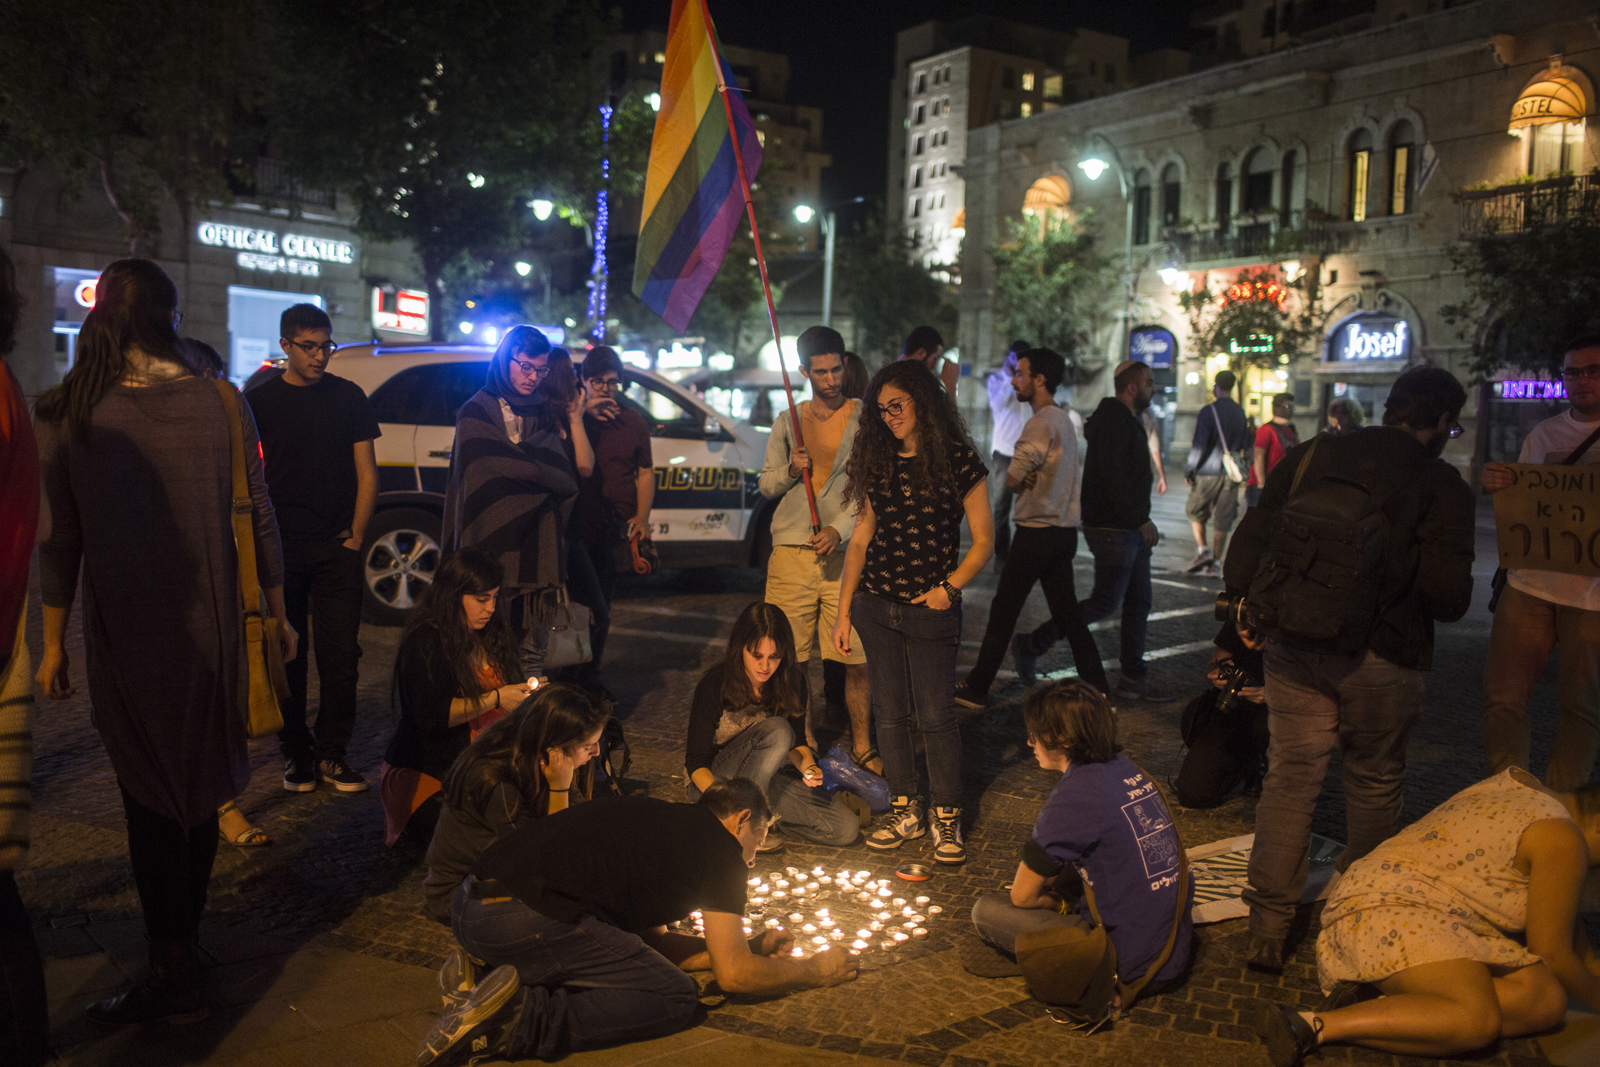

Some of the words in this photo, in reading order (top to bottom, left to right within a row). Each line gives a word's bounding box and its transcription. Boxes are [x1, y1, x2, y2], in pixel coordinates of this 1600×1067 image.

[198, 222, 279, 253] OPTICAL
[282, 234, 353, 264] CENTER
[1344, 321, 1407, 359] Josef
[654, 466, 741, 491] משטר
[1537, 500, 1585, 522] היא
[472, 1035, 487, 1052] N
